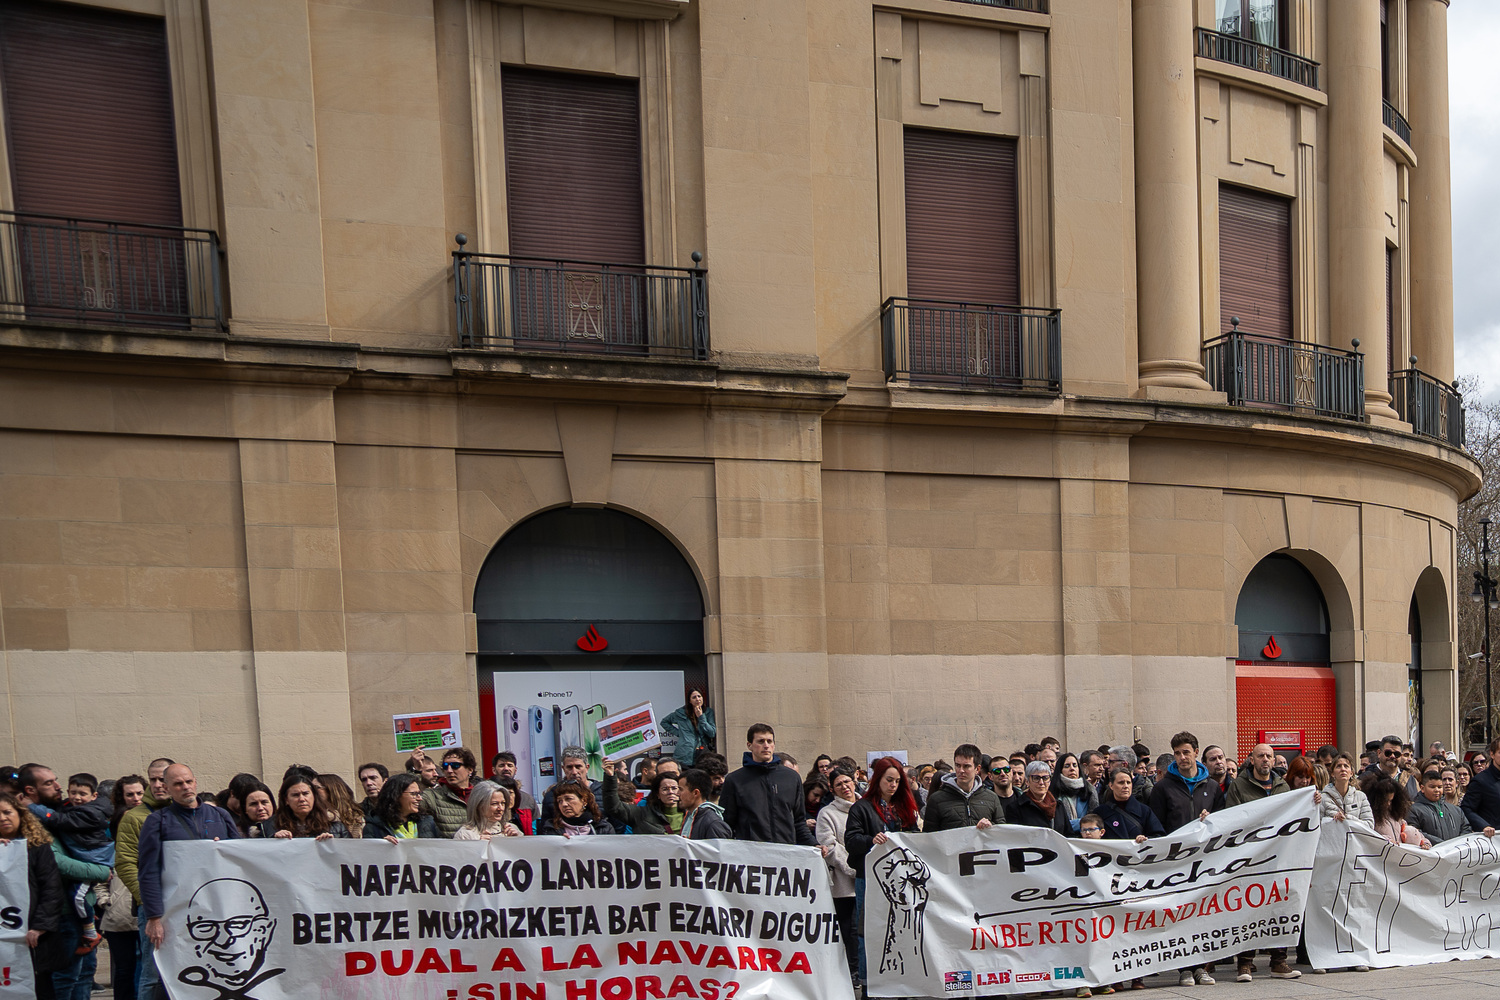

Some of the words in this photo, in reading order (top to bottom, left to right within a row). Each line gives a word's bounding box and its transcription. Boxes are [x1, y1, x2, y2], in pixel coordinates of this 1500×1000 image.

[340, 858, 534, 897] NAFARROAKO
[540, 858, 661, 890] LANBIDE
[668, 858, 817, 904] HEZIKETAN,
[959, 847, 1058, 877] FP
[1010, 885, 1096, 902] en
[1109, 853, 1277, 896] lucha
[1443, 873, 1474, 908] DE
[292, 909, 410, 945] BERTZE
[417, 905, 603, 940] MURRIZKETA
[608, 902, 661, 935] BAT
[669, 902, 754, 938] EZARRI
[758, 910, 841, 945] DIGUTE
[970, 914, 1116, 950] INBERTSIO
[1123, 877, 1290, 934] HANDIAGOA!
[1112, 937, 1187, 961] ASAMBLEA
[1192, 913, 1301, 942] PROFESORADO
[1114, 959, 1132, 973] LH
[1231, 924, 1301, 946] ASANBLA
[345, 947, 478, 976] DUAL
[491, 947, 526, 972] A
[541, 943, 602, 972] LA
[617, 940, 813, 975] NAVARRA
[1054, 967, 1086, 980] ELA
[977, 970, 1012, 986] LAB
[1016, 974, 1041, 982] CCOO
